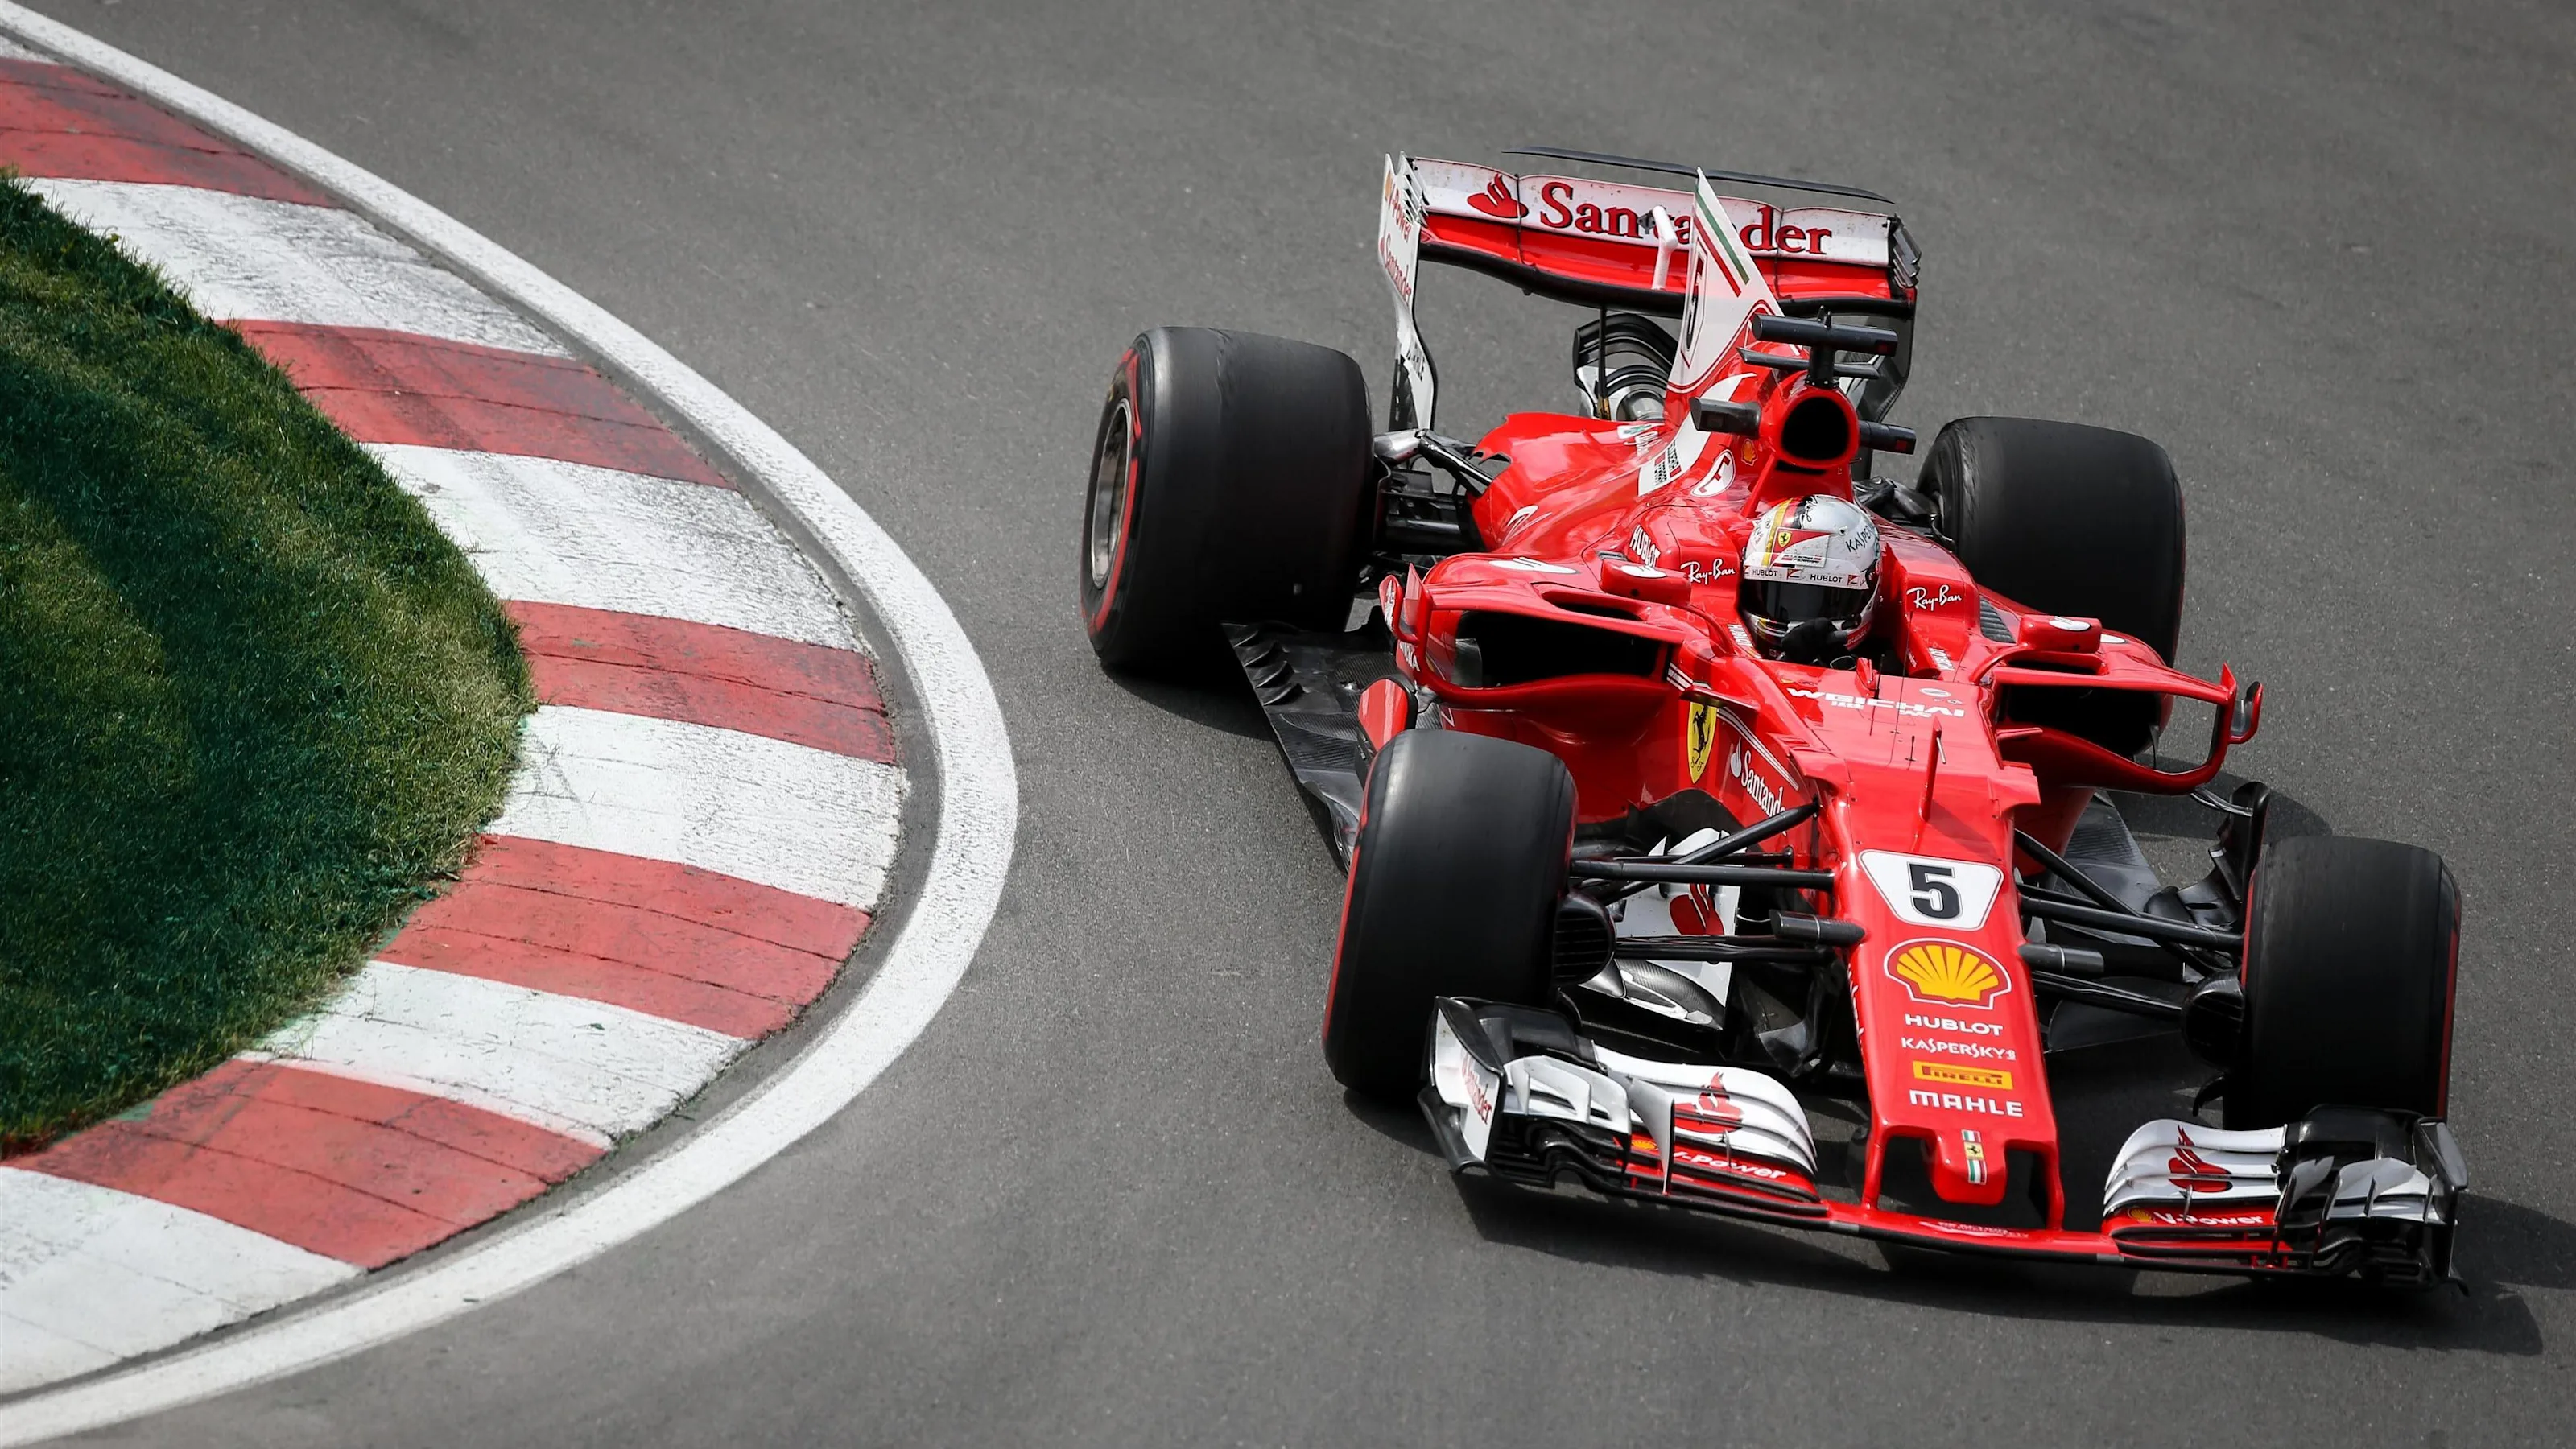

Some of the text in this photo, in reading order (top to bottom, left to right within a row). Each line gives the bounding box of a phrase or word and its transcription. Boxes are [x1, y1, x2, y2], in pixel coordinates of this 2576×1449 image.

[1540, 181, 1832, 254] Sanader
[1629, 524, 1661, 568] HUBLOT
[1680, 558, 1736, 585] Ray-Ban
[1752, 569, 1778, 577] HUBLOT
[1810, 574, 1843, 583] HUBLOT
[1906, 584, 1962, 611] Ray-Ban
[1786, 687, 1964, 717] WEICHAI
[1741, 750, 1786, 818] Santand
[1906, 862, 1963, 919] 5
[1905, 1013, 2004, 1037] HUBLOT
[1901, 1037, 2005, 1059] KASPERSKY
[1922, 1064, 2003, 1085] PIRELLI
[1909, 1089, 2024, 1117] MAHLE
